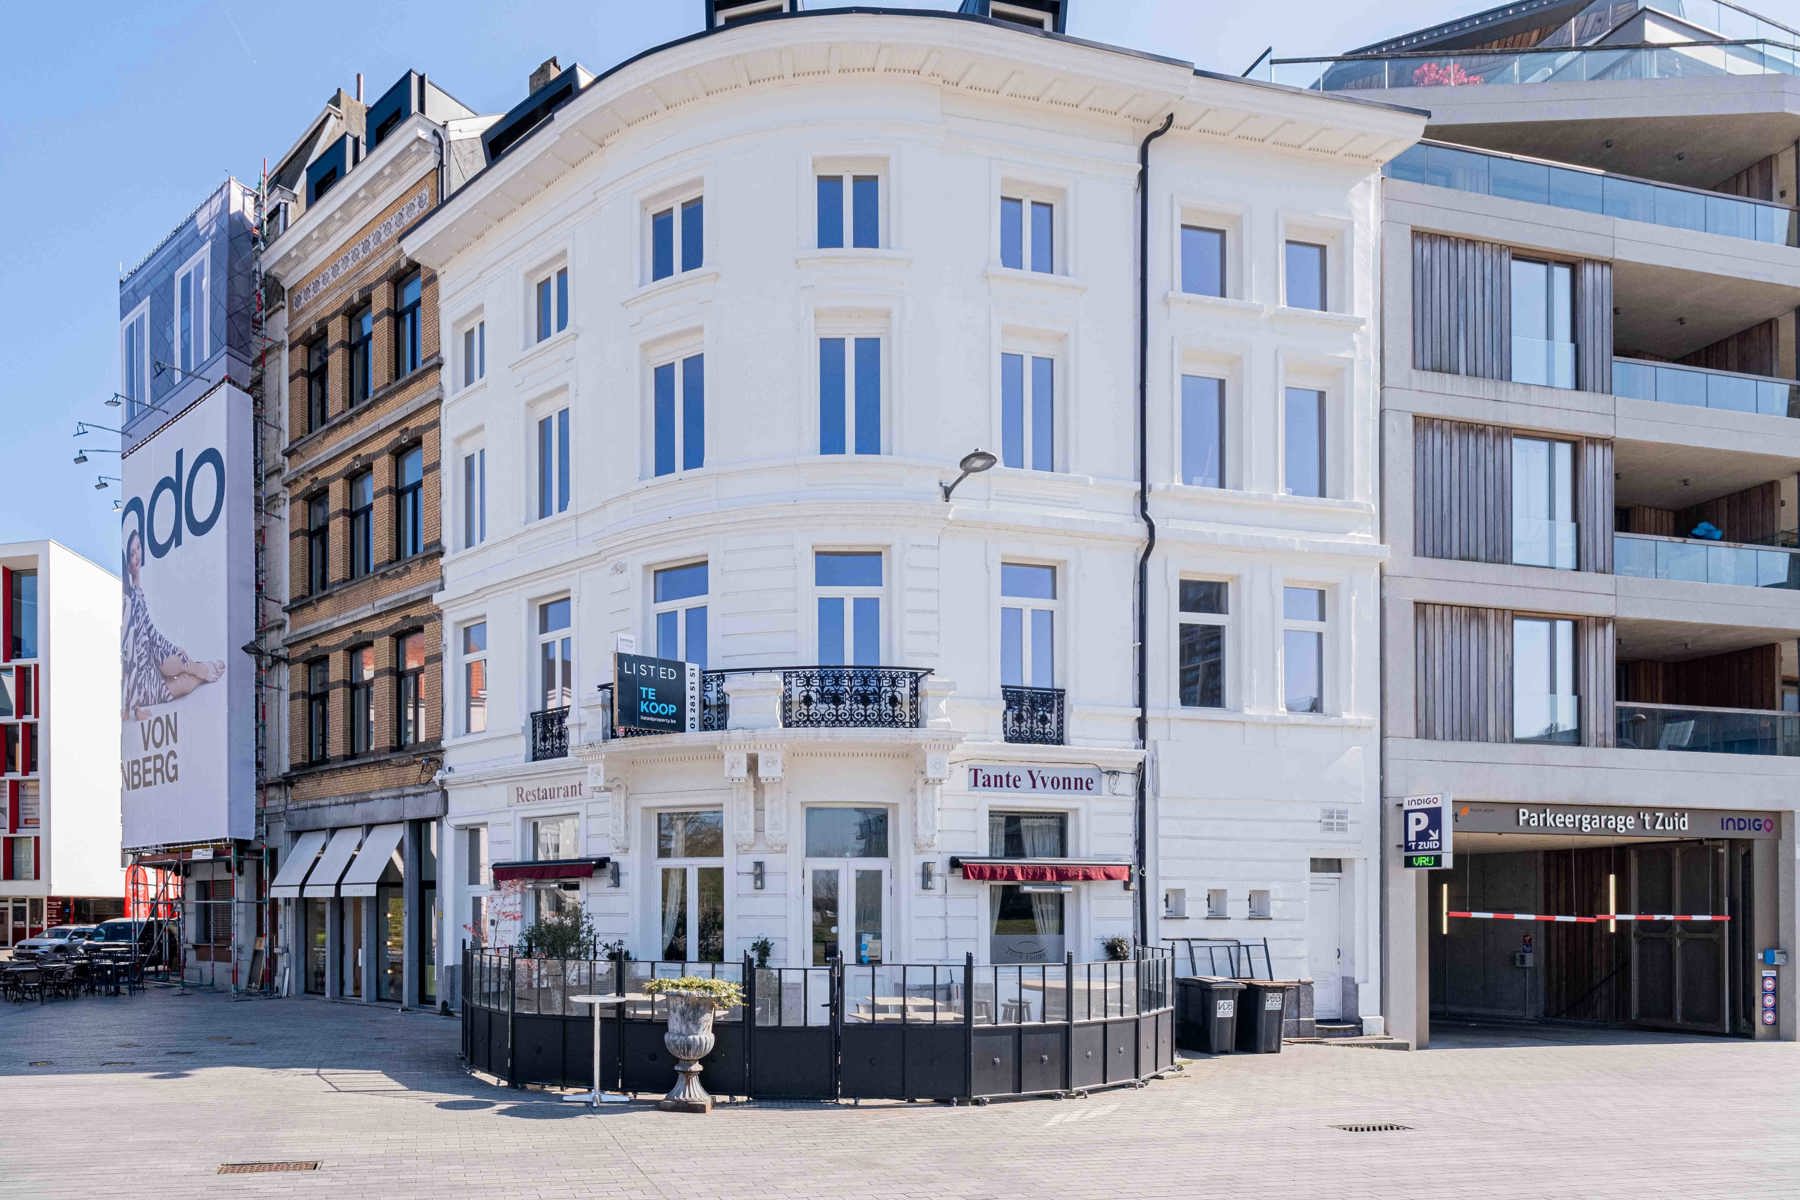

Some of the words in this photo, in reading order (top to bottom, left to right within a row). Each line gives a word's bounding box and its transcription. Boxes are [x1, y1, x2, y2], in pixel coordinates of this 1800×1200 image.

[624, 661, 677, 680] LISTED
[640, 687, 656, 700] TE
[640, 701, 677, 716] KOOP
[140, 712, 178, 751] VON
[969, 768, 1021, 789] Tante
[1027, 770, 1094, 791] Yvonne
[516, 782, 583, 803] Restaurant
[1408, 797, 1438, 806] INDIGO
[1408, 812, 1429, 841] P
[1518, 808, 1635, 834] Parkeergarage
[1639, 811, 1651, 830] 't
[1655, 812, 1689, 831] Zuid
[1721, 817, 1774, 833] INDIGO
[1418, 841, 1440, 849] ZUID
